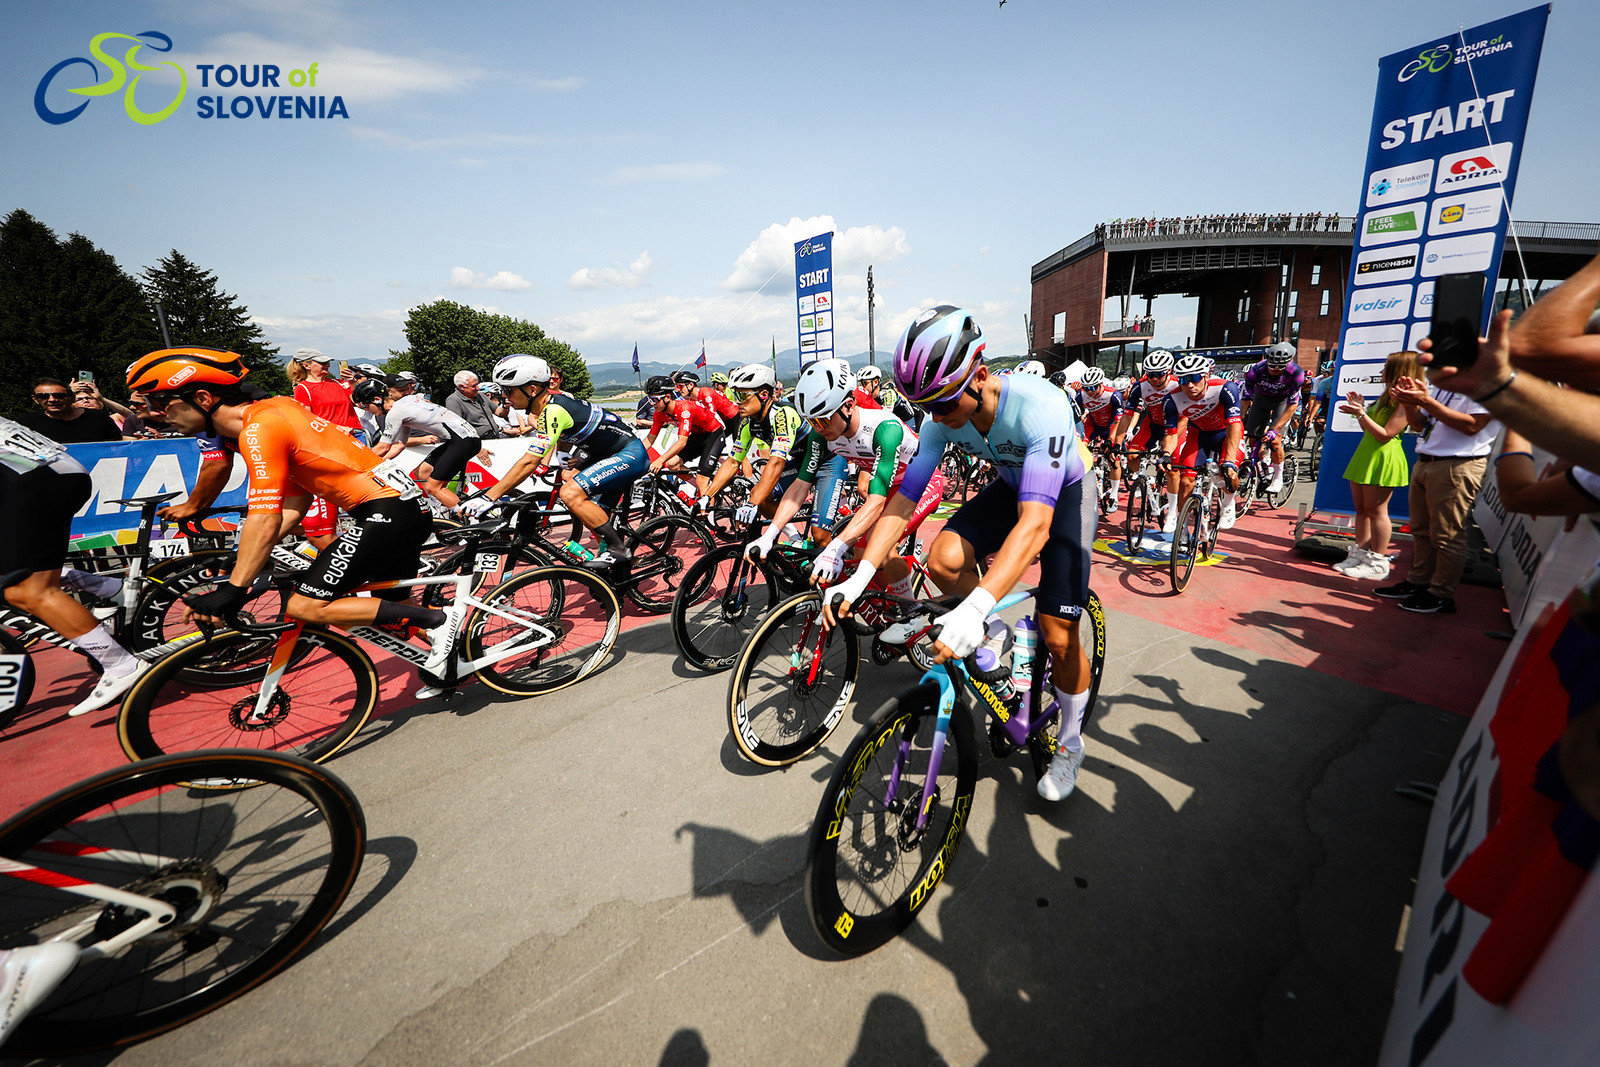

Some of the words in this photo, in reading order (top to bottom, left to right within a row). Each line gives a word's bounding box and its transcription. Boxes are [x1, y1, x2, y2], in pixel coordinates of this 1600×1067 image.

[1454, 41, 1513, 64] SLOVENIA
[1455, 40, 1488, 56] TOUR
[1490, 34, 1503, 45] of
[1380, 89, 1515, 150] START
[1397, 173, 1430, 184] Telekom
[1441, 168, 1502, 185] ADRIA
[1374, 216, 1395, 224] FEEL
[800, 268, 830, 289] START
[1354, 298, 1403, 312] valsir
[245, 422, 270, 480] euskaltel
[806, 441, 820, 474] KOMETA
[590, 466, 617, 486] Solution
[613, 462, 631, 474] Tech
[160, 545, 185, 557] 174
[323, 526, 364, 586] euskaltel
[1510, 516, 1542, 586] ADRIA
[480, 554, 499, 571] 133
